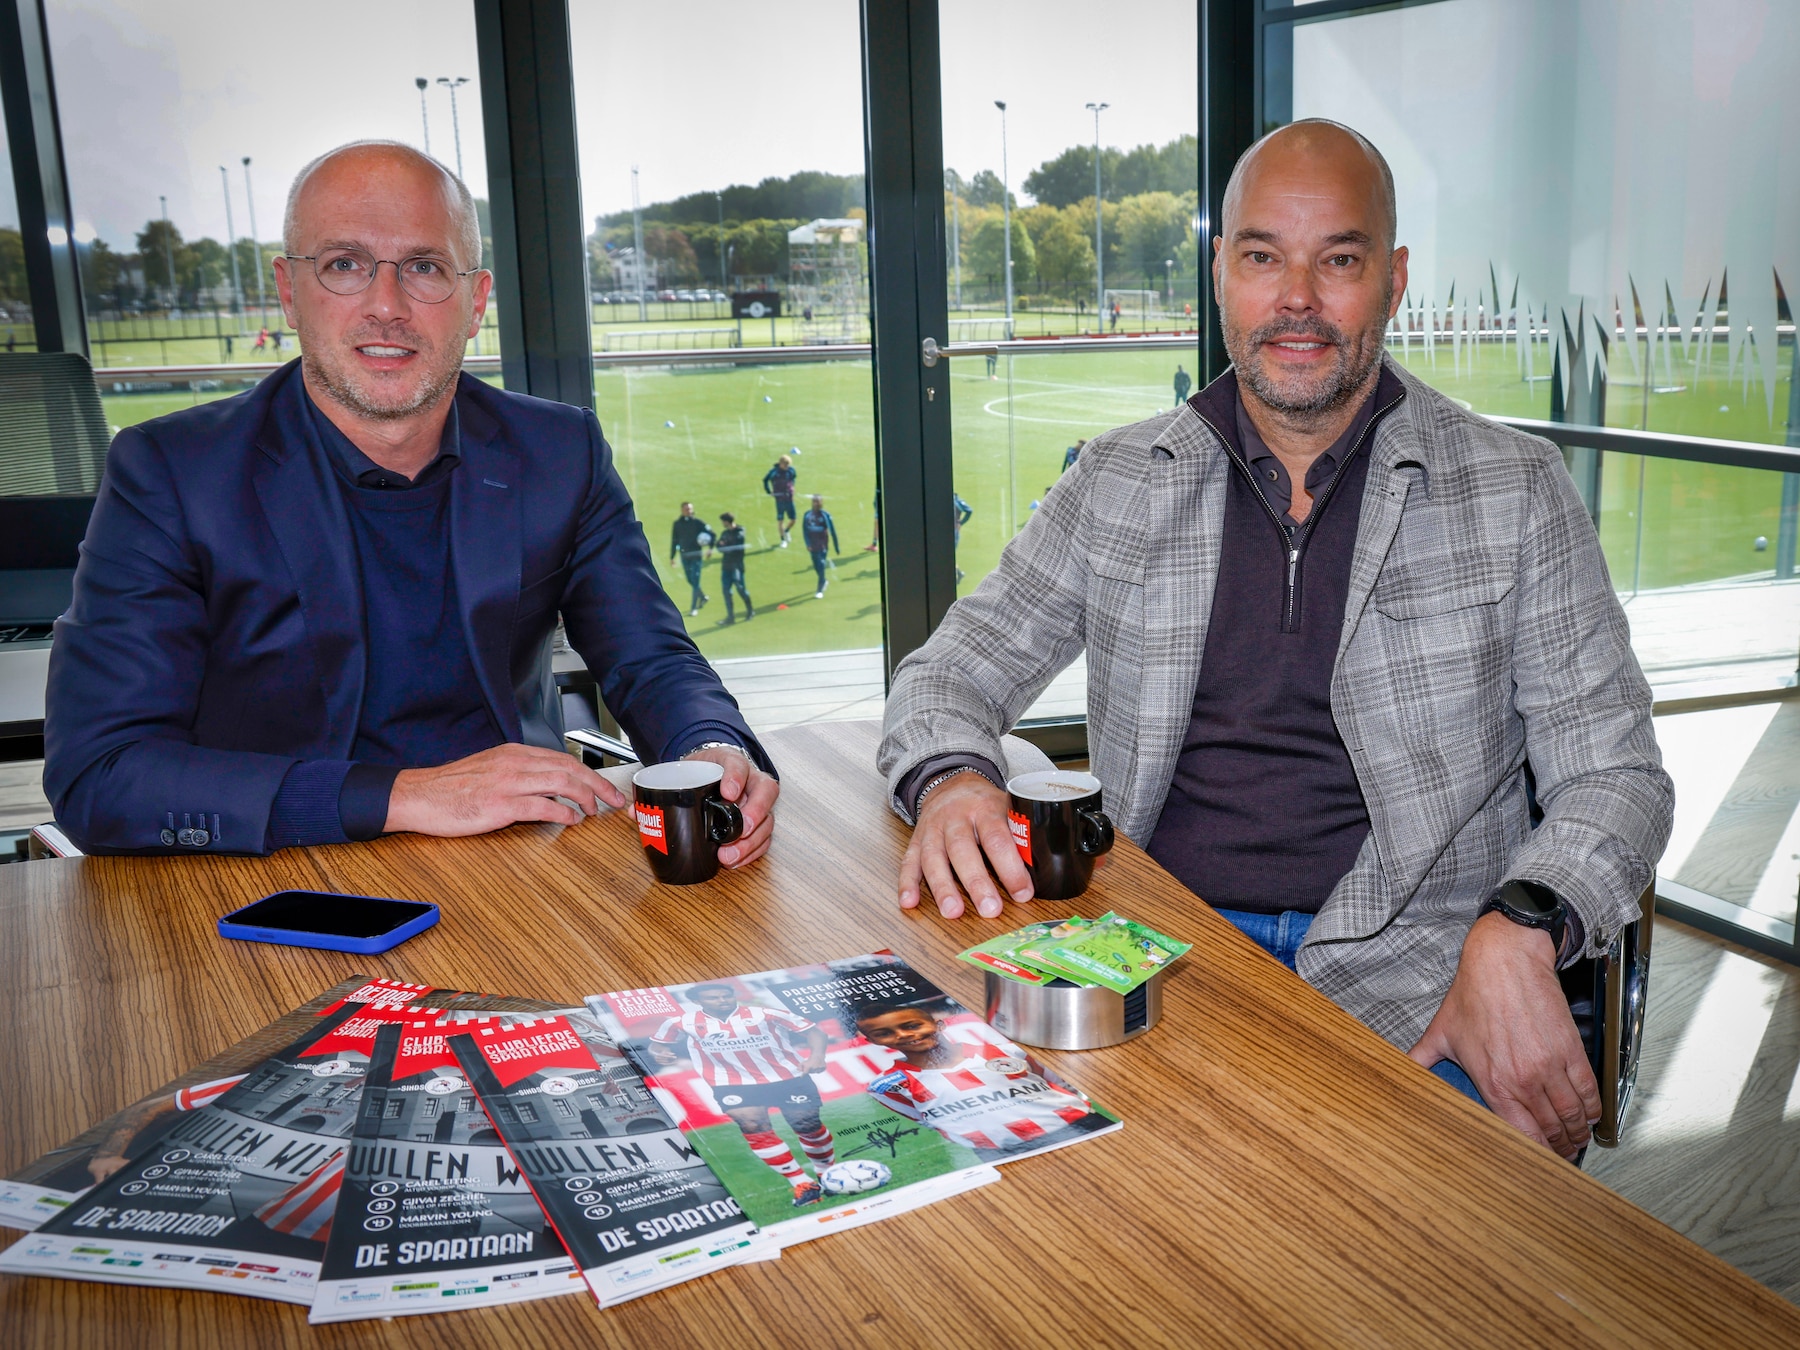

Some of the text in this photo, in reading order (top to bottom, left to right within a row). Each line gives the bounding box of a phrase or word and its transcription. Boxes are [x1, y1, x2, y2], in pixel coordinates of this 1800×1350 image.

[782, 970, 898, 998] PRESENTATIEGIDS
[792, 977, 907, 1006] JEUGDOPLEIDING
[616, 993, 668, 1007] JEUGD
[619, 1002, 673, 1013] OPLEIDING
[345, 1017, 387, 1030] CLUB
[404, 1035, 447, 1048] CLUB
[484, 1030, 572, 1056] CLUBLIEFDE
[701, 1034, 770, 1048] de Goudse
[490, 1038, 581, 1064] SPARTAANS
[871, 1115, 900, 1129] YOUNG
[596, 1167, 629, 1180] CAREL
[405, 1177, 481, 1188] CAREL EITING
[615, 1181, 701, 1209] MARVIN YOUNG
[73, 1206, 237, 1237] DE SPARTAAN
[400, 1209, 494, 1223] MARVIN YOUNG
[597, 1196, 742, 1253] DE SPARTAA
[355, 1231, 534, 1269] DE SPARTAAN
